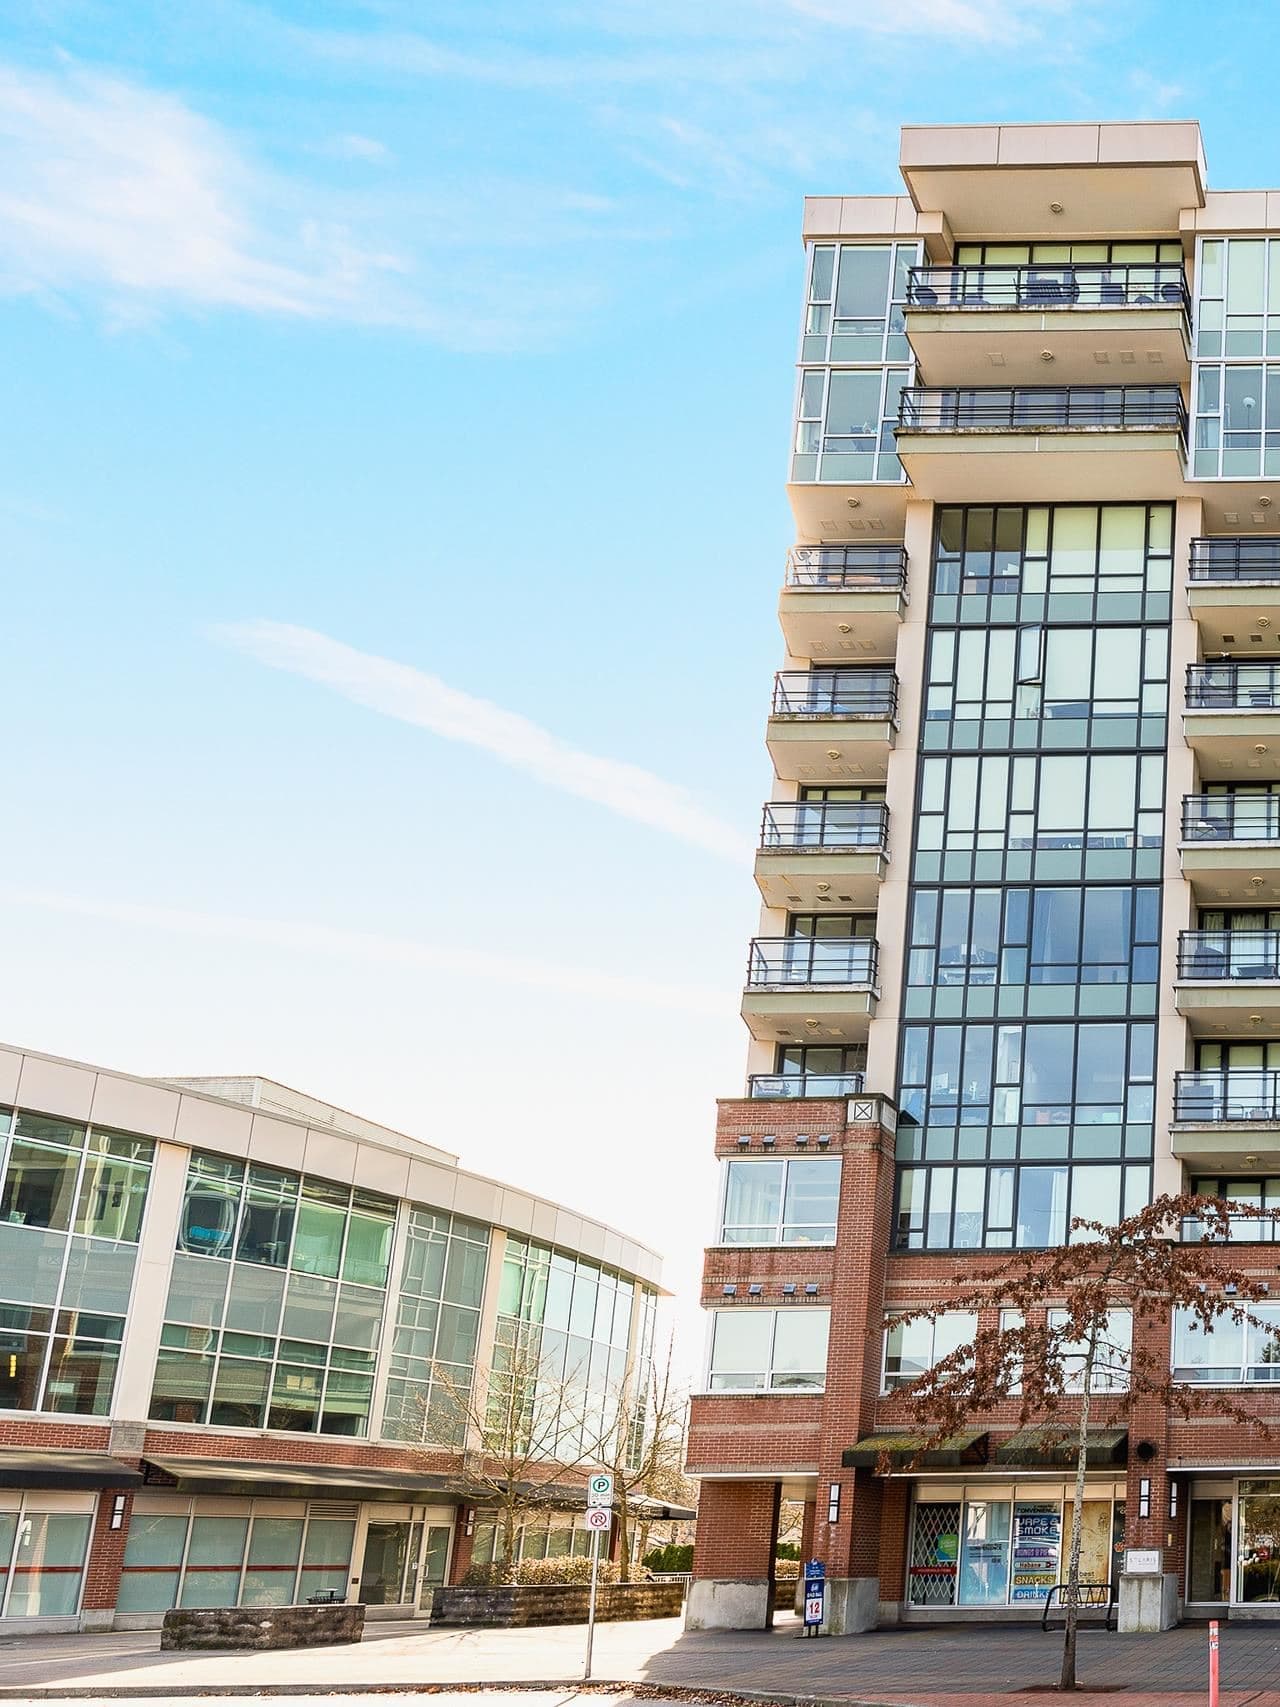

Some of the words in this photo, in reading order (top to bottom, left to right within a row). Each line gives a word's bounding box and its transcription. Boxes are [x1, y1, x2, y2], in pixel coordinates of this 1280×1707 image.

[598, 1481, 605, 1489] P
[1016, 1517, 1049, 1526] VAPE
[1016, 1526, 1057, 1535] SMOKE
[1015, 1576, 1054, 1585] SNACKS
[809, 1602, 820, 1614] 12
